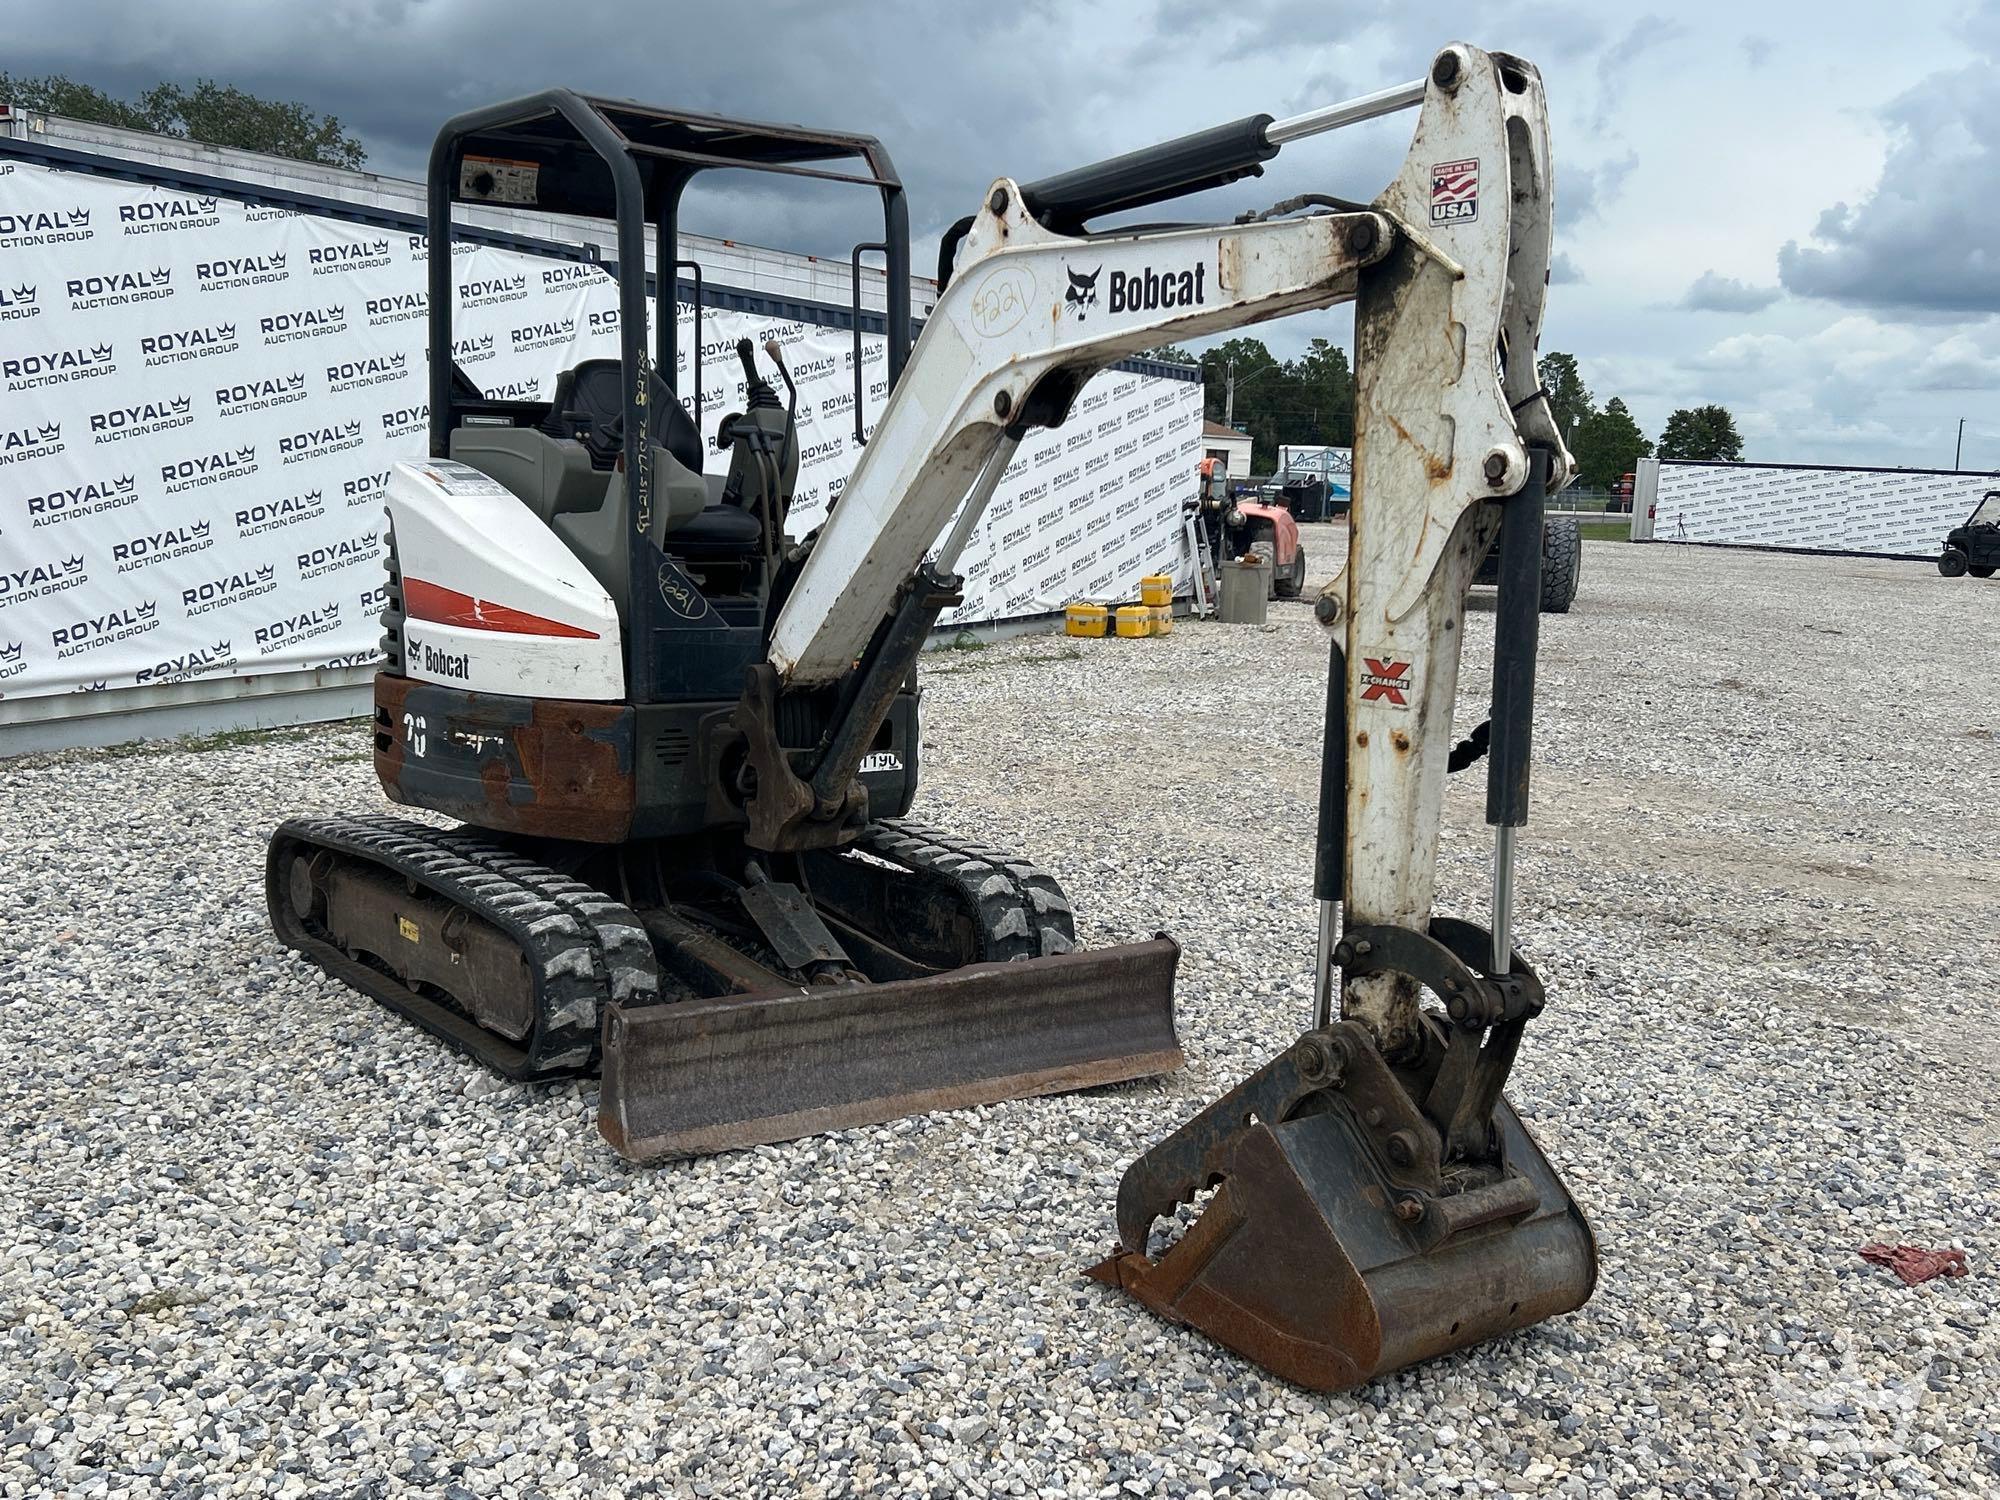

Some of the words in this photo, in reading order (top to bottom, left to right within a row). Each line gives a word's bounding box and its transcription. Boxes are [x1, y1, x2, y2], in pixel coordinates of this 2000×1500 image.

[119, 200, 198, 222] ROYAL
[1434, 201, 1473, 219] USA
[0, 212, 68, 234] OYAL
[124, 222, 177, 235] AUCTION
[180, 218, 220, 229] GROUP
[0, 235, 44, 248] CTION
[47, 230, 93, 243] GROUP
[309, 243, 373, 264] ROYAL
[196, 257, 269, 280] ROYAL
[313, 263, 356, 276] AUCTION
[358, 258, 391, 269] GROUP
[542, 265, 590, 284] ROYAL
[66, 272, 151, 297] ROYAL
[200, 278, 250, 292] AUCTION
[252, 272, 289, 284] GROUP
[459, 278, 512, 298] ROYAL
[545, 283, 578, 294] AUCTION
[579, 277, 609, 288] GROUP
[1109, 262, 1204, 313] Bobcat
[72, 295, 129, 310] AUCTION
[131, 288, 174, 302] GROUP
[366, 293, 426, 315] ROYAL
[462, 296, 498, 309] AUCTION
[500, 292, 527, 302] GROUP
[0, 307, 40, 321] ROUP
[260, 310, 328, 334] ROYAL
[370, 312, 410, 326] AUCTION
[412, 310, 428, 318] GRO
[141, 328, 217, 354] ROYAL
[264, 330, 310, 345] AUCTION
[312, 324, 347, 336] GROUP
[511, 322, 562, 343] ROYAL
[514, 340, 548, 353] AUCTION
[550, 334, 576, 346] GROUP
[760, 325, 794, 342] ROYAL
[145, 350, 197, 367] AUCTION
[200, 343, 238, 357] GROUP
[452, 338, 480, 354] YAL
[466, 350, 496, 364] GROUP
[3, 350, 92, 378] ROYAL
[327, 358, 390, 382] ROYAL
[794, 360, 826, 378] ROYAL
[8, 373, 68, 392] AUCTION
[71, 365, 116, 380] GROUP
[330, 378, 373, 393] AUCTION
[375, 370, 408, 383] GROUP
[795, 375, 817, 385] AUCTION
[818, 369, 835, 378] GROUP
[870, 381, 887, 395] ROY
[216, 378, 288, 405] ROYAL
[485, 382, 526, 401] OYAL
[822, 394, 853, 411] ROYAL
[220, 400, 268, 417] AUCTION
[271, 392, 307, 406] GROUP
[824, 408, 844, 419] AUCTION
[90, 402, 171, 432] ROYAL
[382, 406, 430, 428] ROYA
[95, 425, 150, 444] AUCTION
[152, 416, 193, 432] GROUP
[279, 426, 345, 453] ROYAL
[386, 421, 426, 440] AUCTION
[17, 444, 64, 461] GROUP
[283, 447, 328, 465] AUCTION
[330, 438, 363, 453] GROUP
[802, 442, 834, 461] ROYAL
[802, 457, 825, 468] AUCTION
[826, 450, 842, 460] GROUP
[162, 452, 237, 482] ROYAL
[166, 475, 217, 494] AUCTION
[219, 465, 258, 480] GROUP
[28, 482, 114, 515] ROYAL
[347, 490, 386, 508] AUCTIO
[33, 506, 92, 528] AUCTION
[94, 495, 138, 512] GROUP
[236, 496, 306, 526] ROYAL
[240, 518, 287, 538] AUCTION
[289, 508, 324, 524] GROUP
[113, 528, 192, 561] ROYAL
[298, 539, 362, 570] ROYAL
[118, 551, 171, 574] AUCTION
[173, 539, 213, 557] GROUP
[301, 560, 345, 581] AUCTION
[346, 549, 380, 566] GROUP
[0, 564, 62, 594] OYAL
[182, 572, 256, 606] ROYAL
[0, 588, 38, 608] CTION
[42, 575, 88, 595] GROUP
[187, 595, 236, 618] AUCTION
[239, 582, 277, 600] GROUP
[952, 602, 976, 620] ROYAL
[52, 610, 136, 647] ROYAL
[254, 611, 323, 644] ROYAL
[261, 633, 305, 655] AUCTION
[307, 620, 342, 638] GROUP
[58, 634, 114, 660] AUCTION
[117, 620, 160, 640] GROUP
[0, 662, 27, 679] OUP
[135, 649, 214, 684] ROYAL
[425, 645, 469, 679] Bobcat
